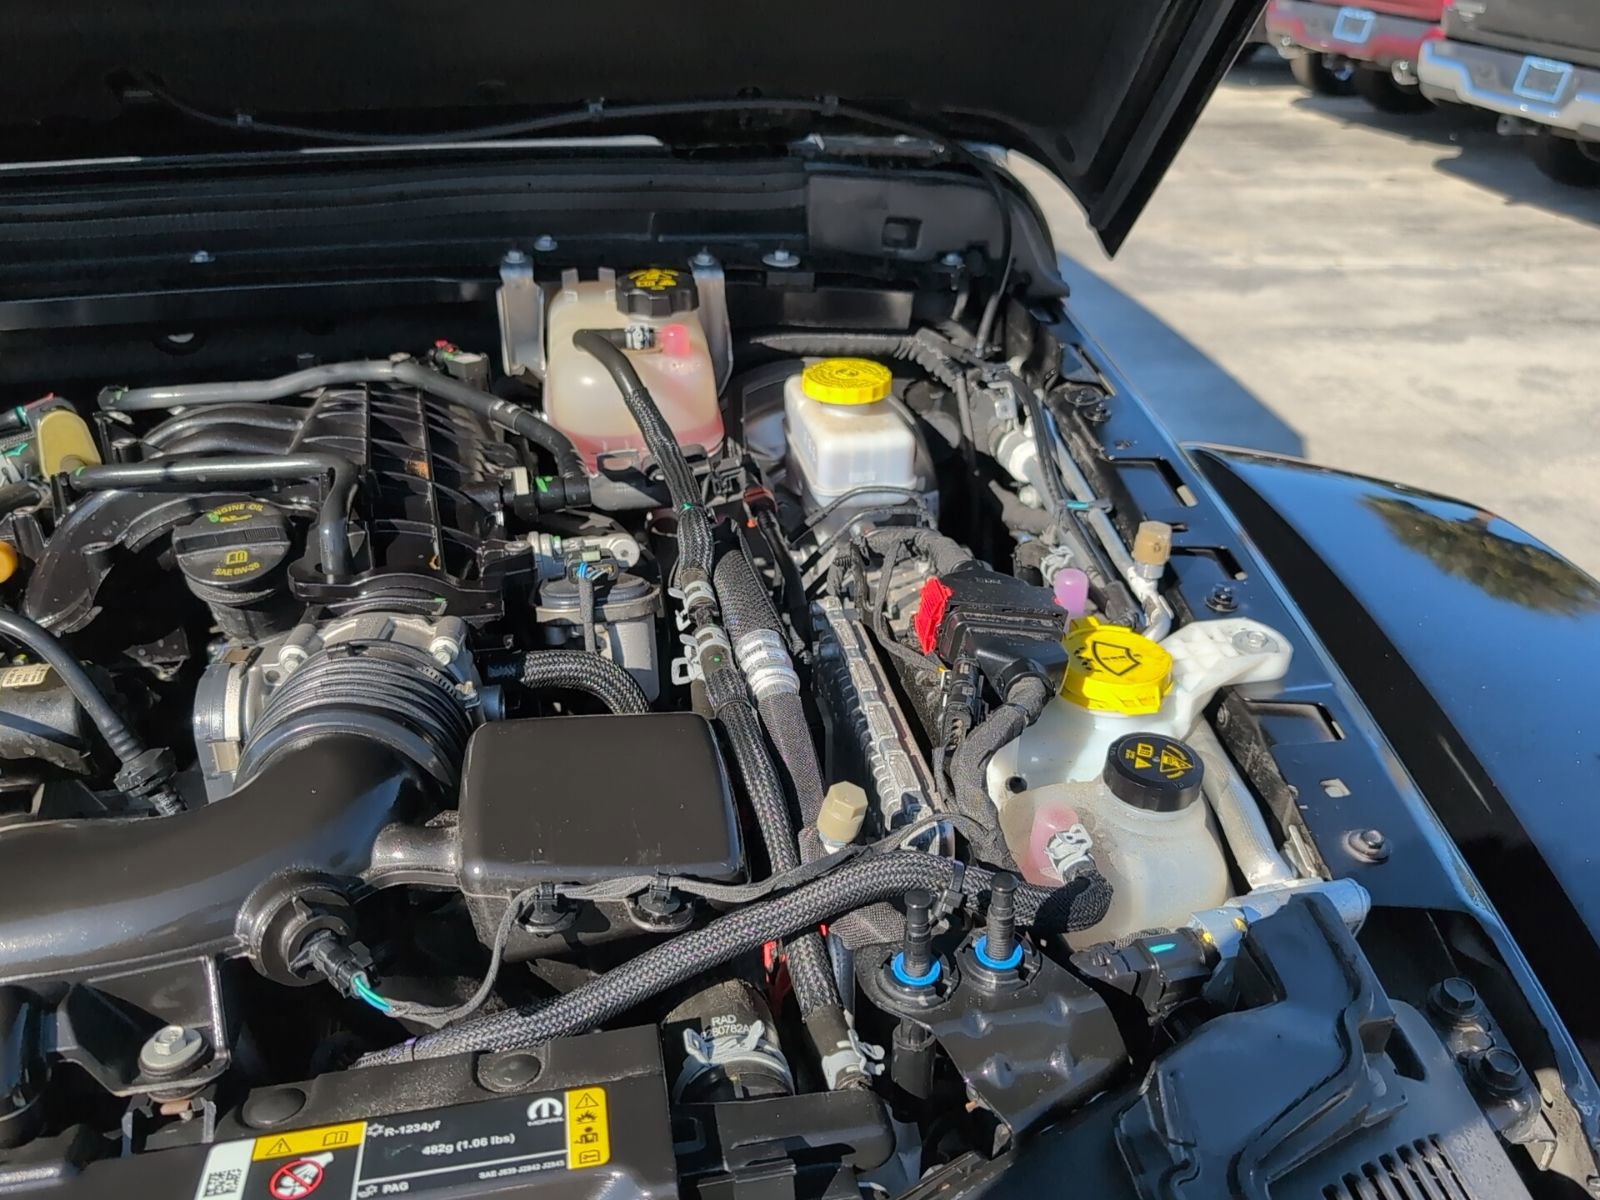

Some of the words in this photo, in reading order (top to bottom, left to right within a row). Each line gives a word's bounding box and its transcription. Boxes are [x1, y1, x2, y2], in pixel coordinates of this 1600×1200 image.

[248, 503, 264, 512] OIL
[214, 567, 233, 577] SAE
[711, 1014, 737, 1026] RAD
[384, 1120, 441, 1137] R-1234yf
[421, 1144, 454, 1156] 482g
[456, 1137, 488, 1152] (1.06
[490, 1132, 516, 1145] lbs)
[478, 1169, 497, 1180] SAE
[382, 1181, 410, 1194] PAG
